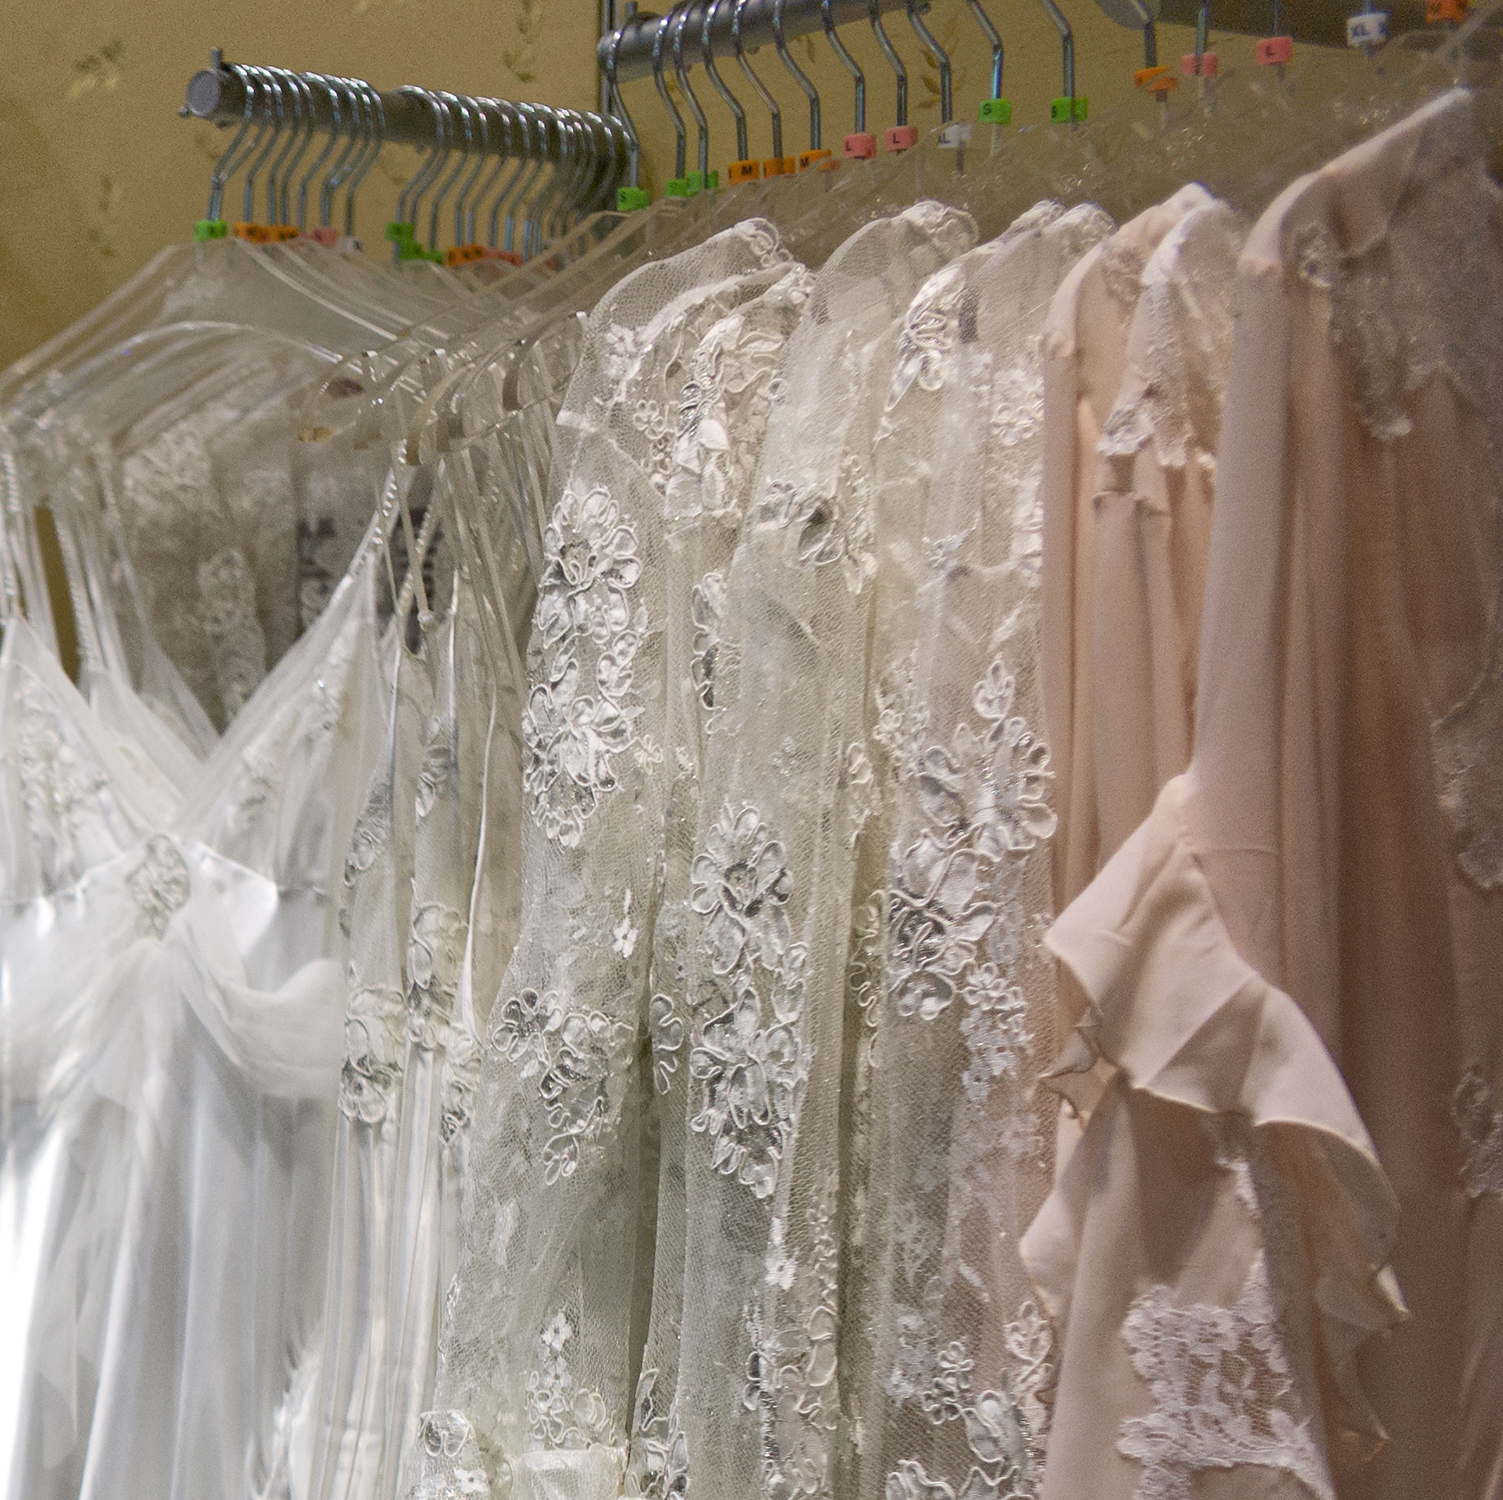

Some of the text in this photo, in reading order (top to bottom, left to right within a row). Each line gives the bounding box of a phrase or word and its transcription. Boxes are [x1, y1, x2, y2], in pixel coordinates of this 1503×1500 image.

[1266, 46, 1275, 57] L
[982, 103, 992, 115] S
[893, 132, 901, 144] L
[845, 141, 852, 152] L
[741, 164, 753, 176] M
